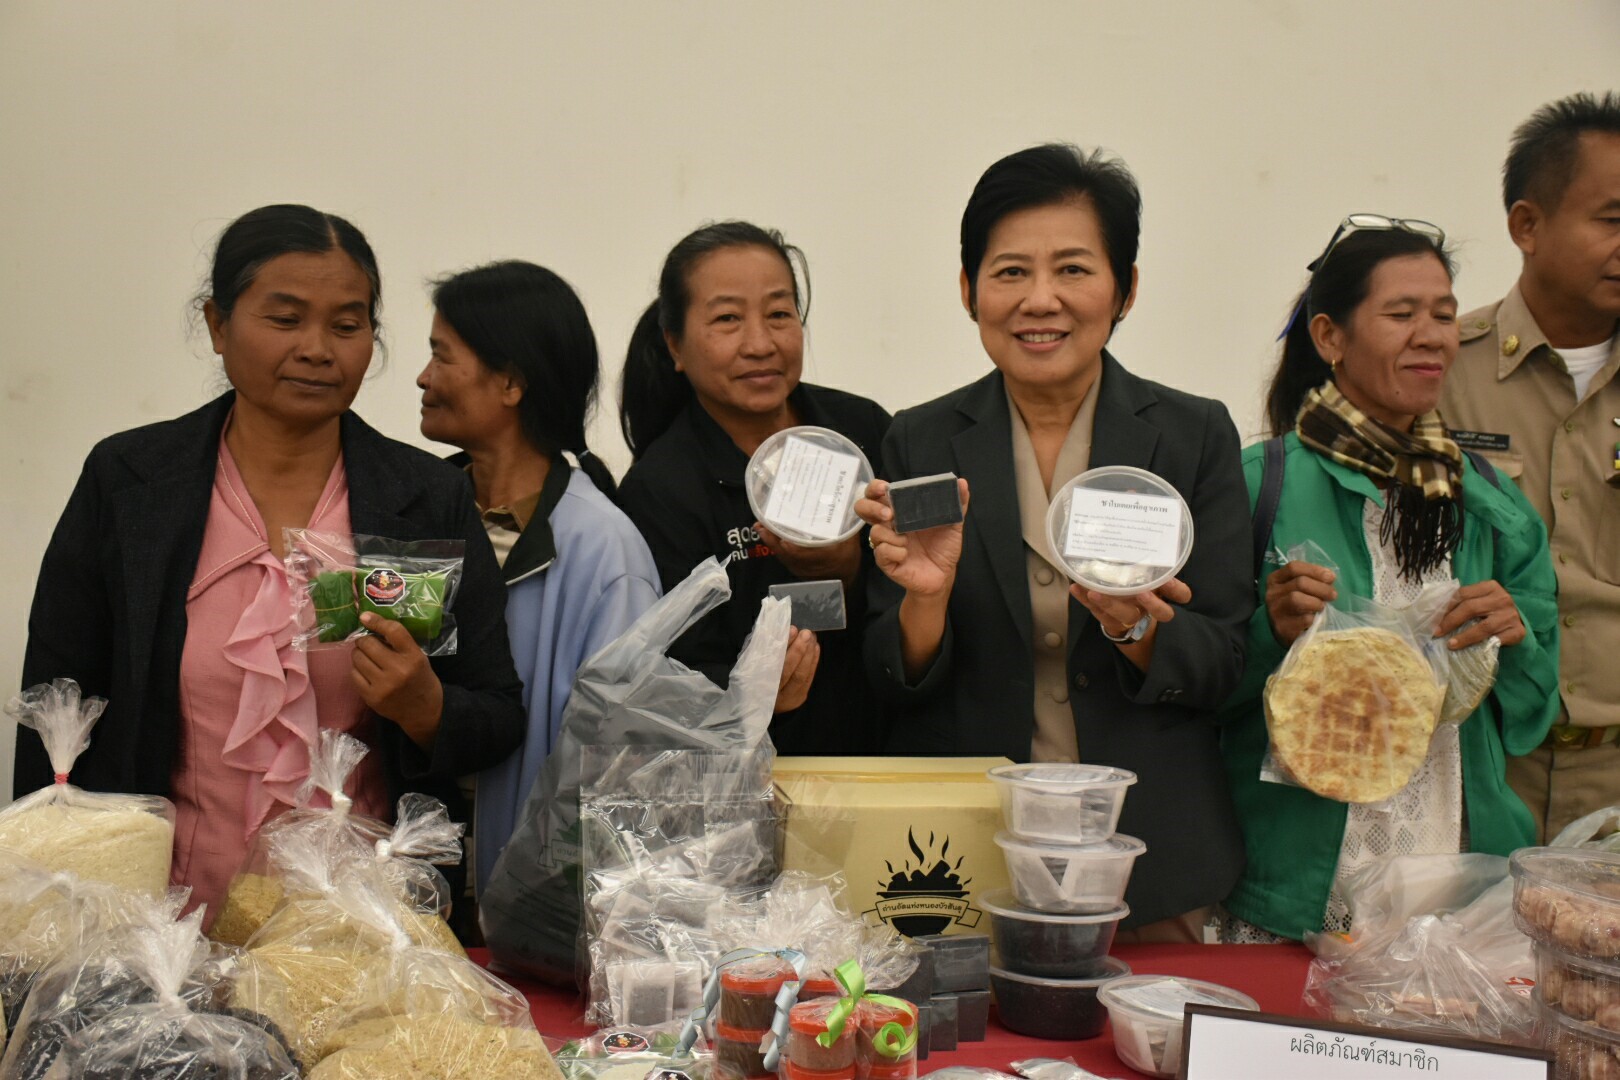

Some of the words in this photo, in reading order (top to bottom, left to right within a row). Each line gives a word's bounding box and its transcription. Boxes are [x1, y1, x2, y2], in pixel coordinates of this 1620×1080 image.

[1290, 1032, 1439, 1072] ผลิตภัณฑ์สมาชิก
